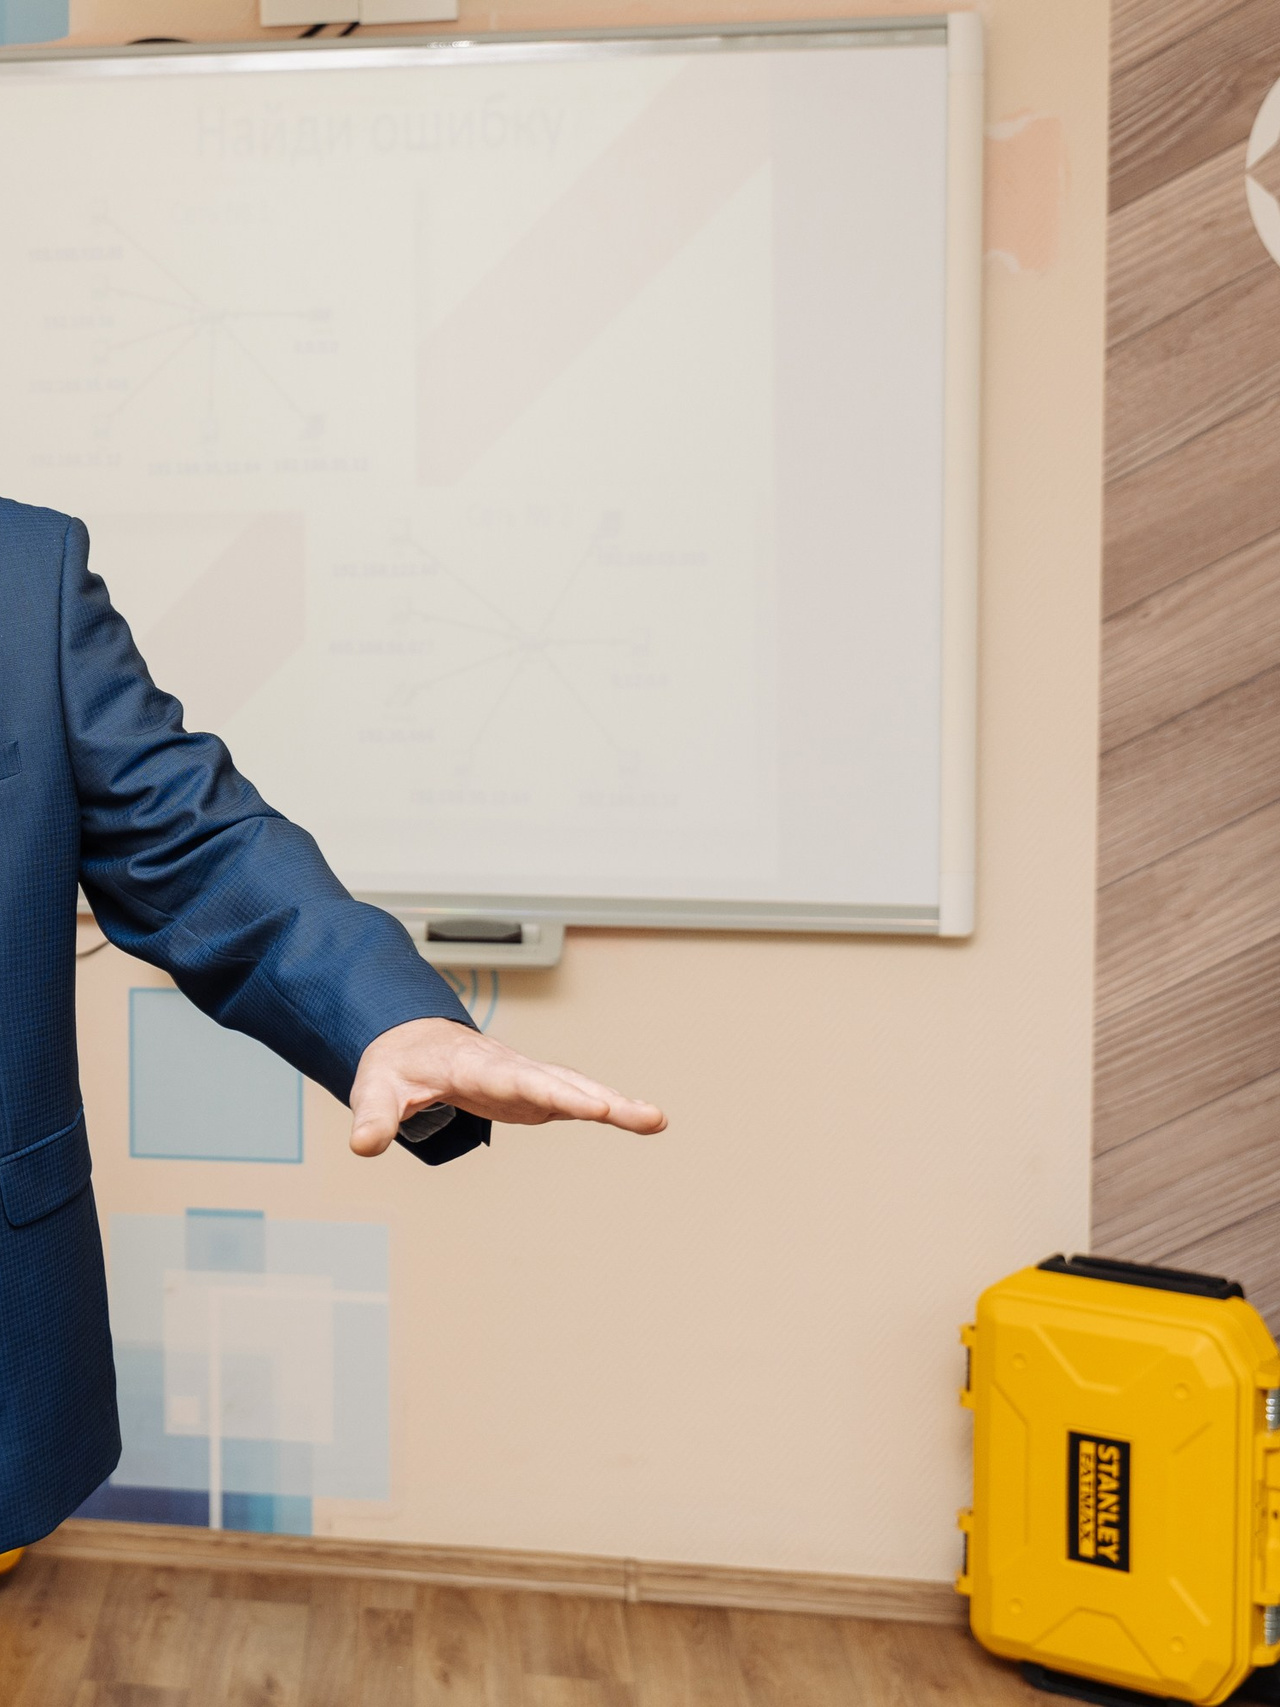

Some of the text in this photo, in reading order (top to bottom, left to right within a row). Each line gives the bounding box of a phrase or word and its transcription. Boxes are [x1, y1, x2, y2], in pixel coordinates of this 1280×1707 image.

[197, 92, 566, 168] Найди ошибку
[1079, 1453, 1093, 1540] FATMAX
[1097, 1443, 1120, 1563] STANLEY
